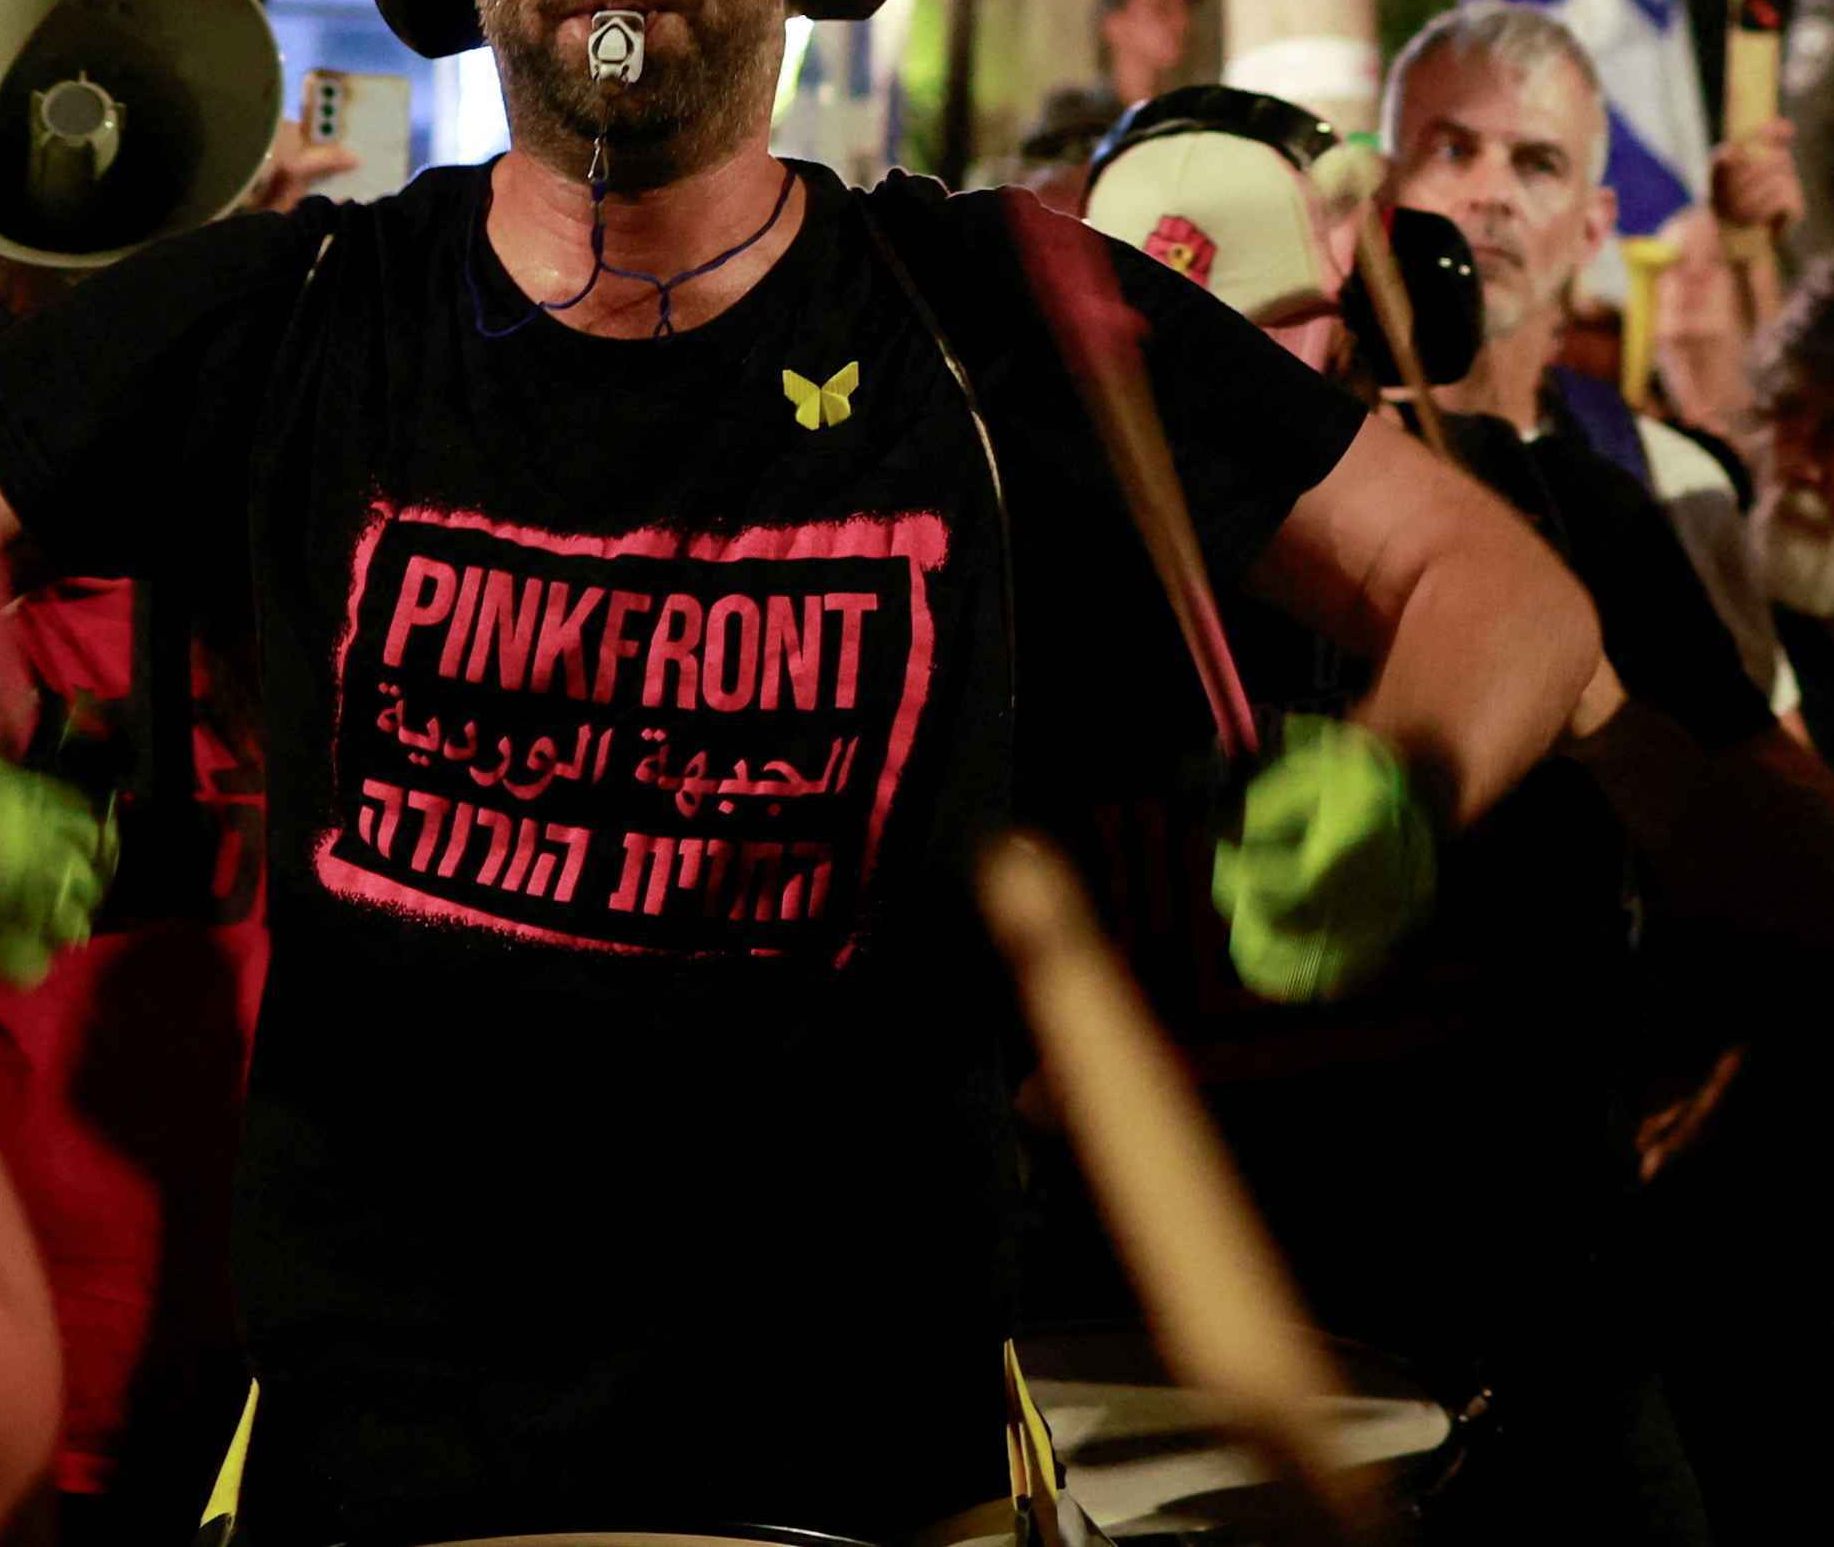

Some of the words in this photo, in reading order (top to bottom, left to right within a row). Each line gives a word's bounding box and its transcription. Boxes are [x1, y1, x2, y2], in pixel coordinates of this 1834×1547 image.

[381, 554, 880, 713] PINKFRONT
[375, 680, 615, 801] الوردية
[634, 725, 863, 819] الجبهة
[358, 775, 592, 905] הורודה
